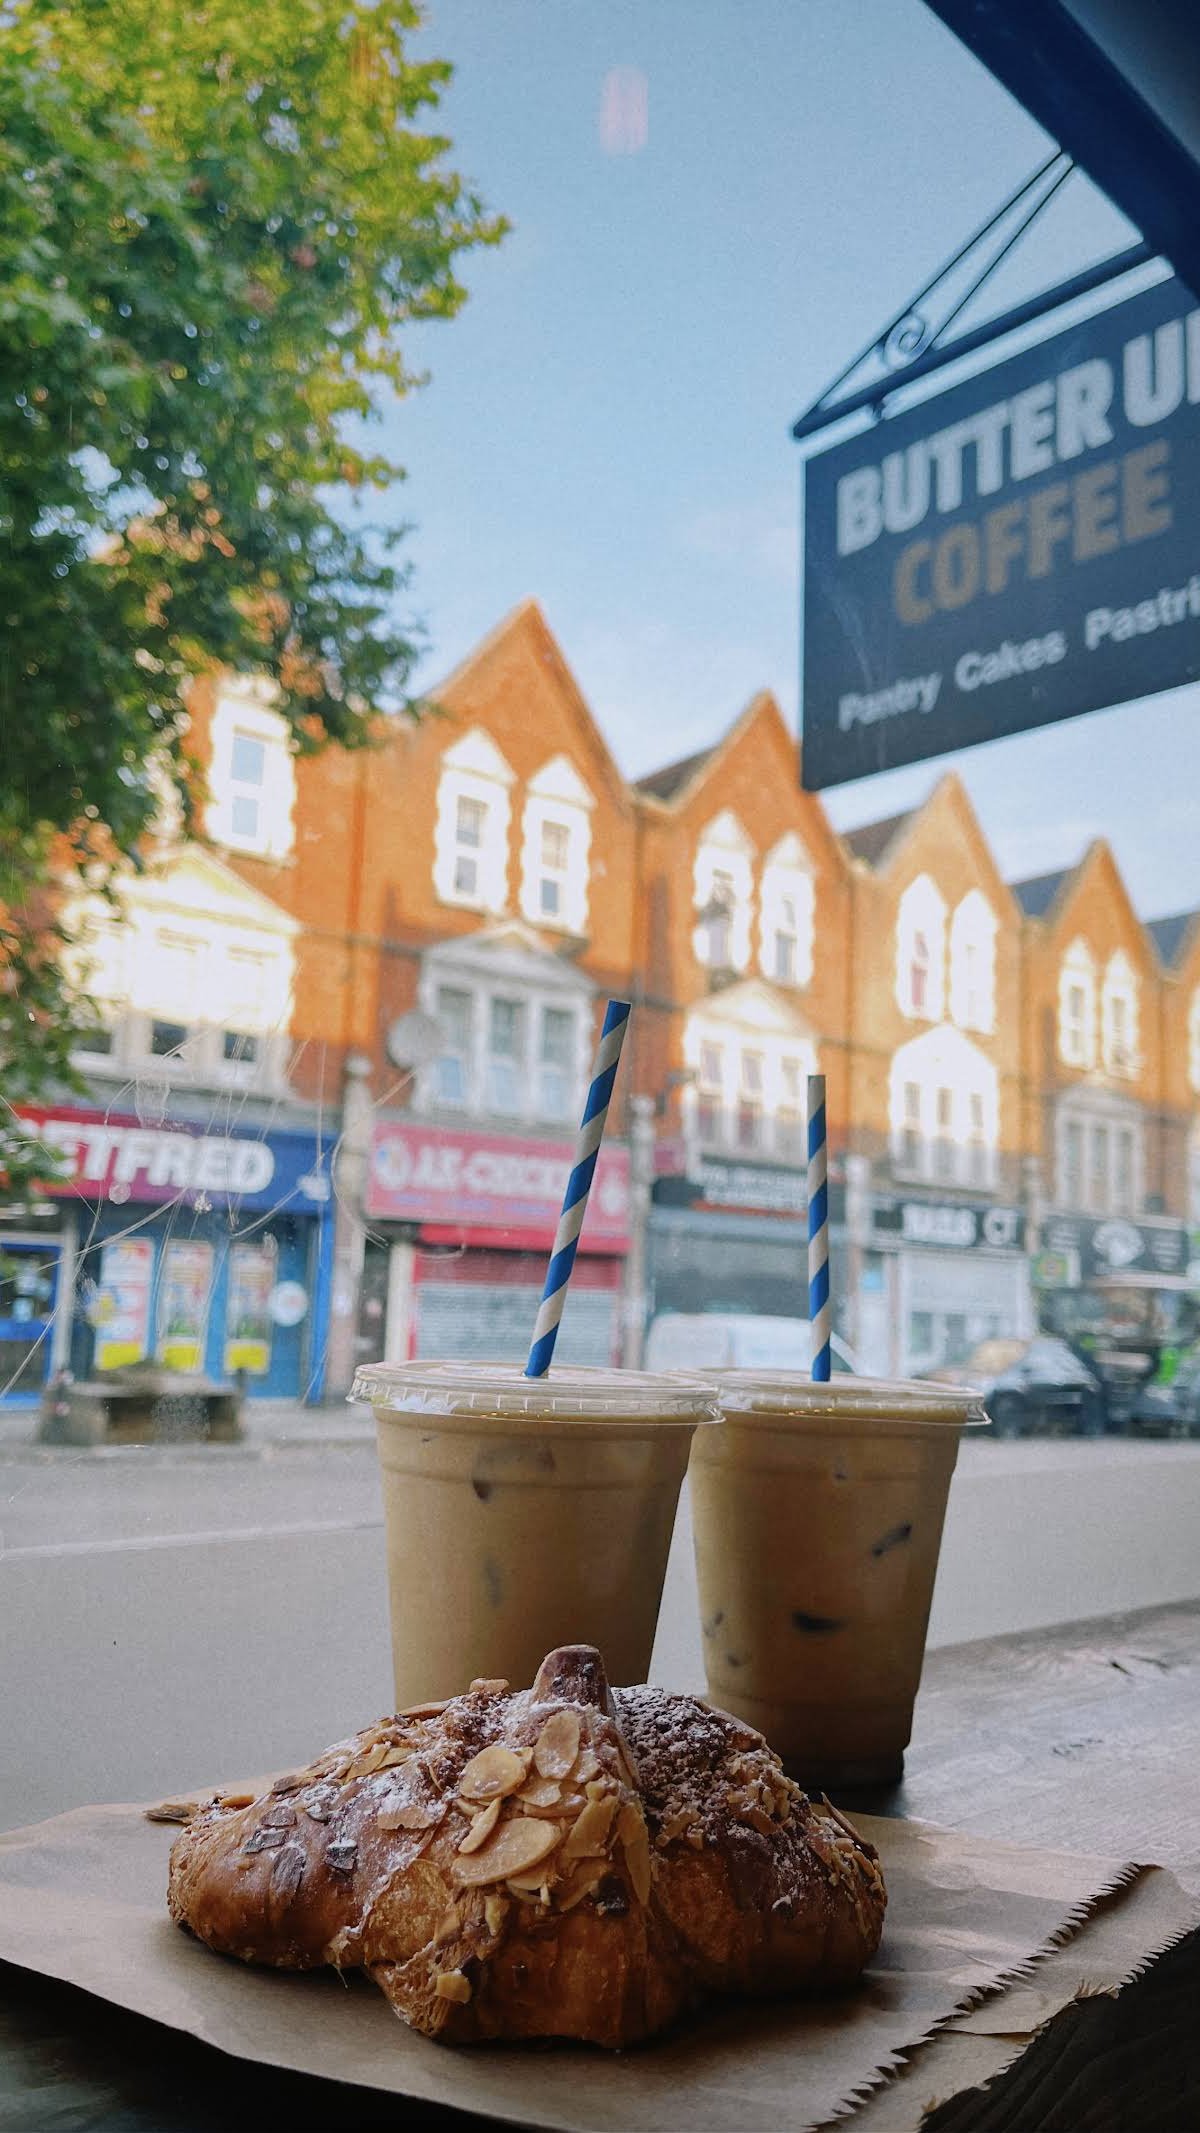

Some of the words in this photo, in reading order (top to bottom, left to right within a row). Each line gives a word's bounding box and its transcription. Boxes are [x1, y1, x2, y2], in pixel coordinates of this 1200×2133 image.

[836, 358, 1114, 556] BUTTER
[893, 438, 1173, 624] COFFEE
[838, 673, 942, 732] Pantry
[955, 630, 1067, 691] Cakes
